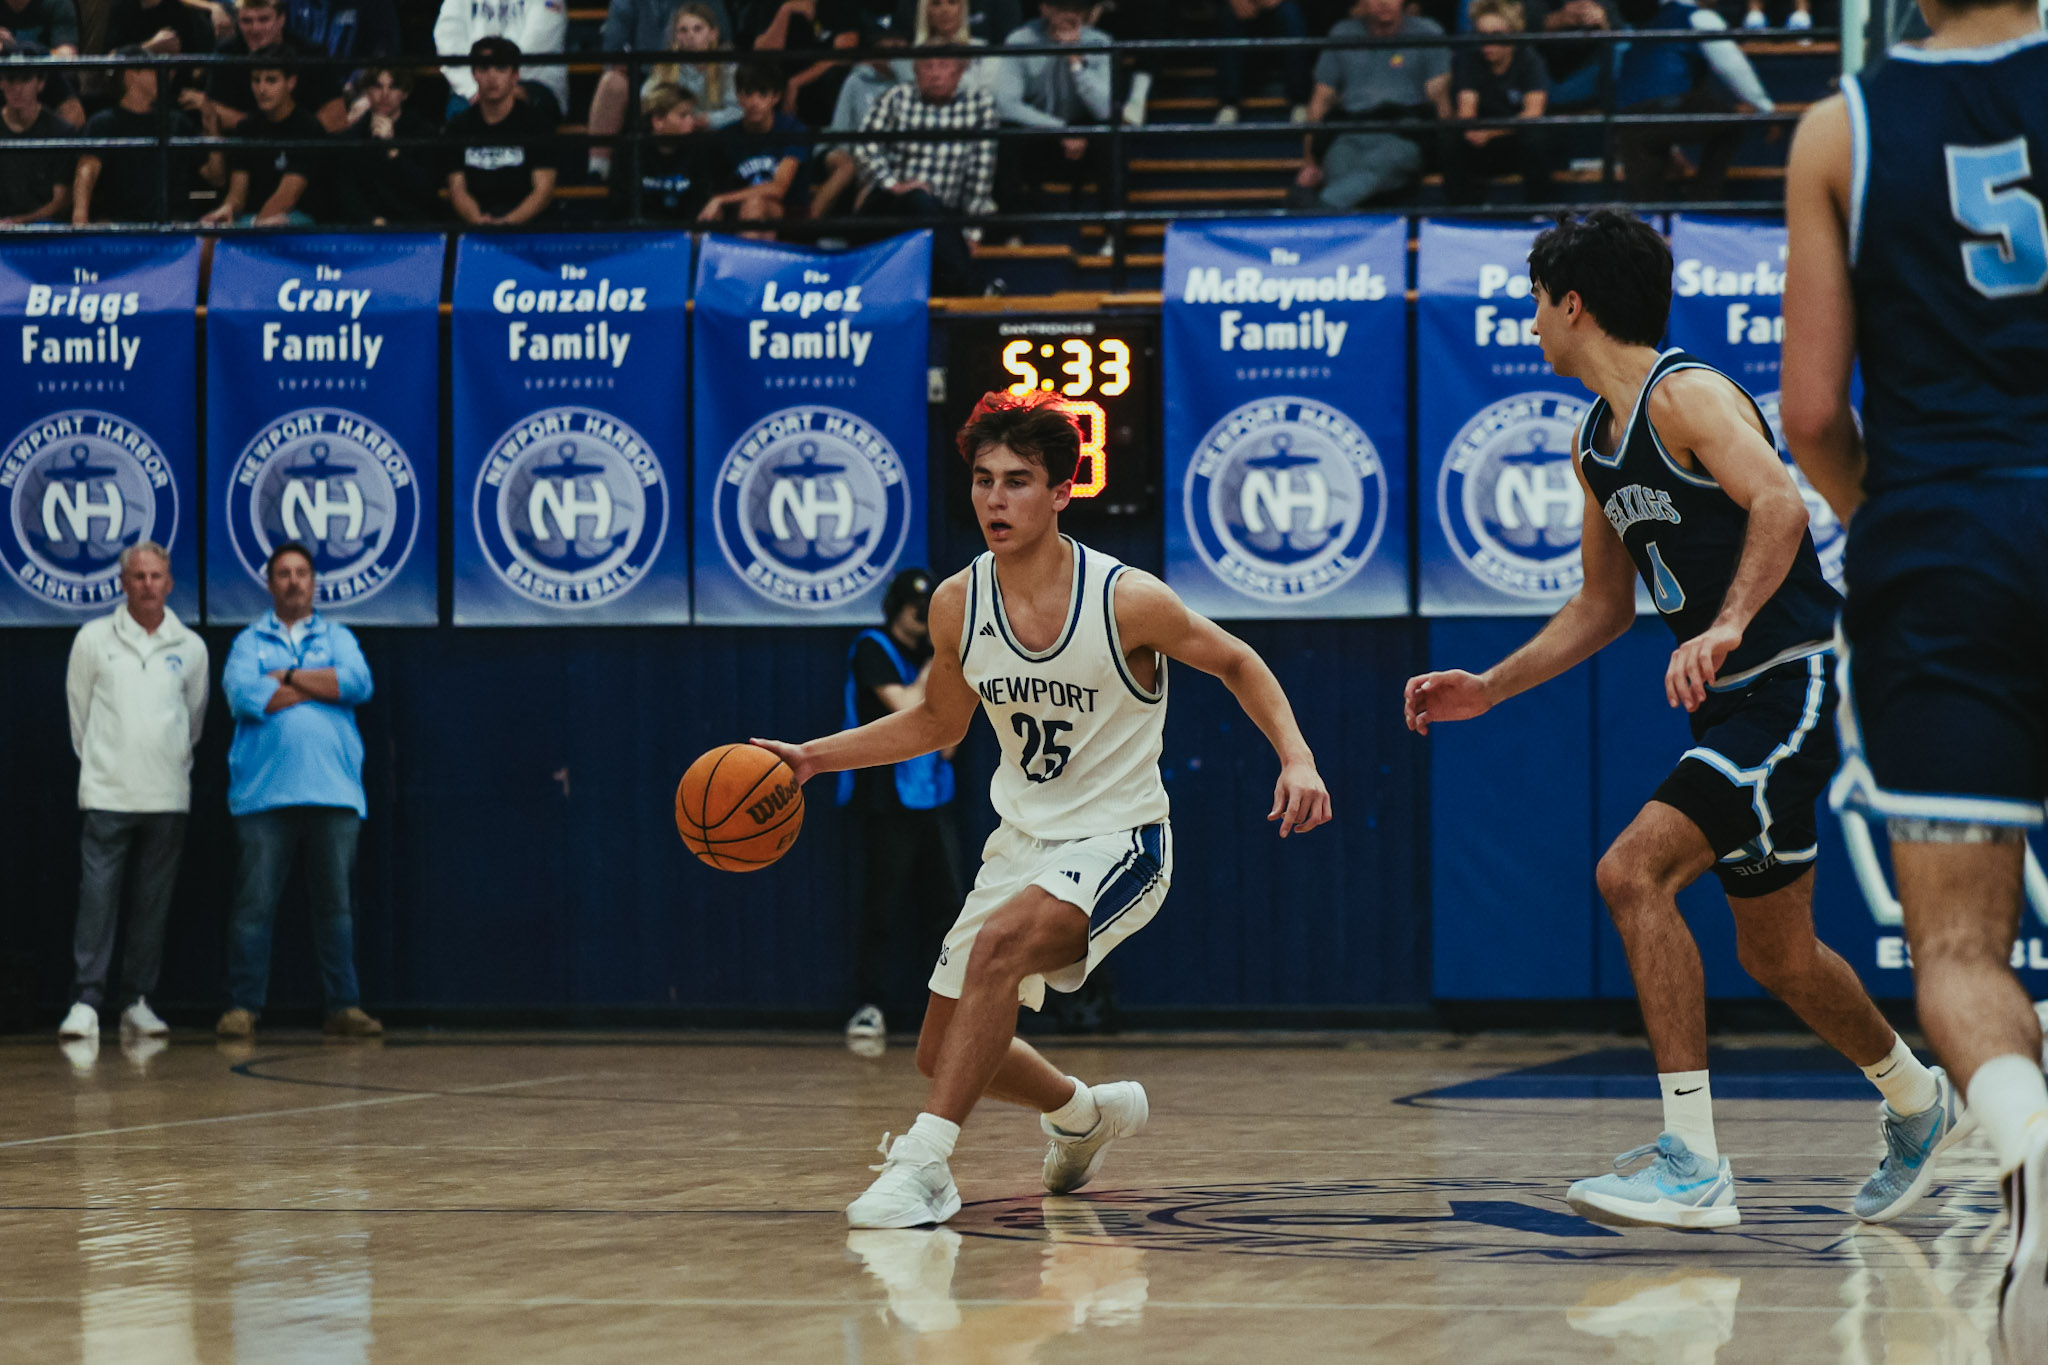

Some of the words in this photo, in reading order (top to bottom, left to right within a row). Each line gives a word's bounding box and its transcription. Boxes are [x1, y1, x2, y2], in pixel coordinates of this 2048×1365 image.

[1943, 135, 2048, 299] 5
[73, 266, 98, 284] The
[316, 265, 342, 281] The
[561, 264, 587, 280] The
[803, 269, 830, 284] The
[1270, 248, 1300, 265] The
[25, 284, 139, 324] Briggs
[278, 278, 371, 319] Crary
[493, 278, 647, 314] Gonzalez
[761, 281, 863, 319] Lopez
[1184, 263, 1387, 310] McReynolds
[22, 325, 141, 371] Family
[263, 322, 383, 369] Family
[509, 320, 631, 368] Family
[749, 318, 873, 367] Family
[1220, 309, 1348, 357] Family
[38, 380, 125, 392] SUPPORTS
[1002, 338, 1130, 397] 5:33
[0, 418, 83, 488] NEWPORT
[97, 420, 168, 488] HARBOR
[239, 413, 325, 487] NEWPORT
[337, 417, 410, 488] HARBOR
[485, 414, 572, 486] NEWPORT
[584, 416, 658, 488] HARBOR
[43, 481, 123, 541] NH
[281, 479, 363, 540] NH
[529, 479, 612, 540] NH
[768, 478, 853, 540] NH
[1240, 468, 1329, 533] NH
[1495, 464, 1584, 529] NH
[506, 560, 639, 601] BASKETBALL
[979, 677, 1098, 712] NEWPORT
[1011, 712, 1073, 783] 25
